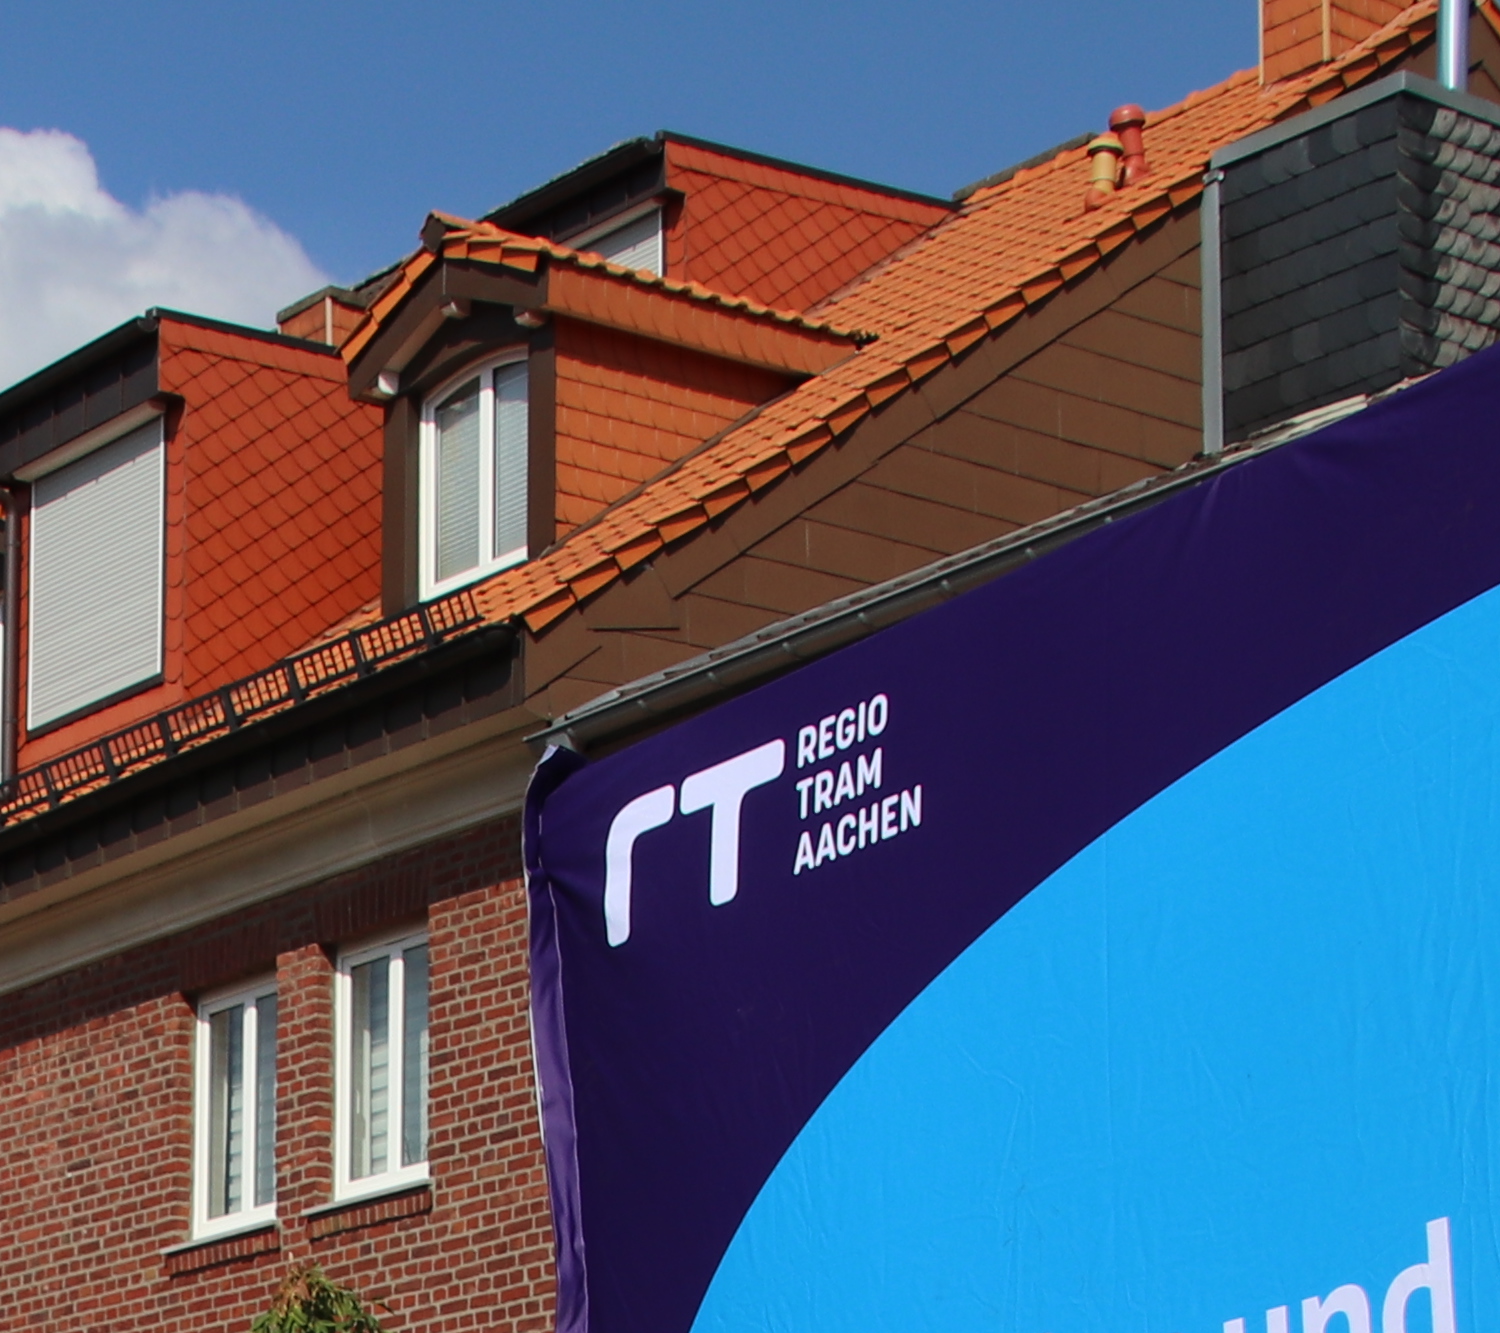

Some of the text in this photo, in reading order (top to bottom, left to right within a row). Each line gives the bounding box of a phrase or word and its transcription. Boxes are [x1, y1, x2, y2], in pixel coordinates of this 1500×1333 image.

[797, 692, 889, 769] REGIO
[795, 746, 884, 820] TRAM
[792, 783, 923, 876] AACHEN
